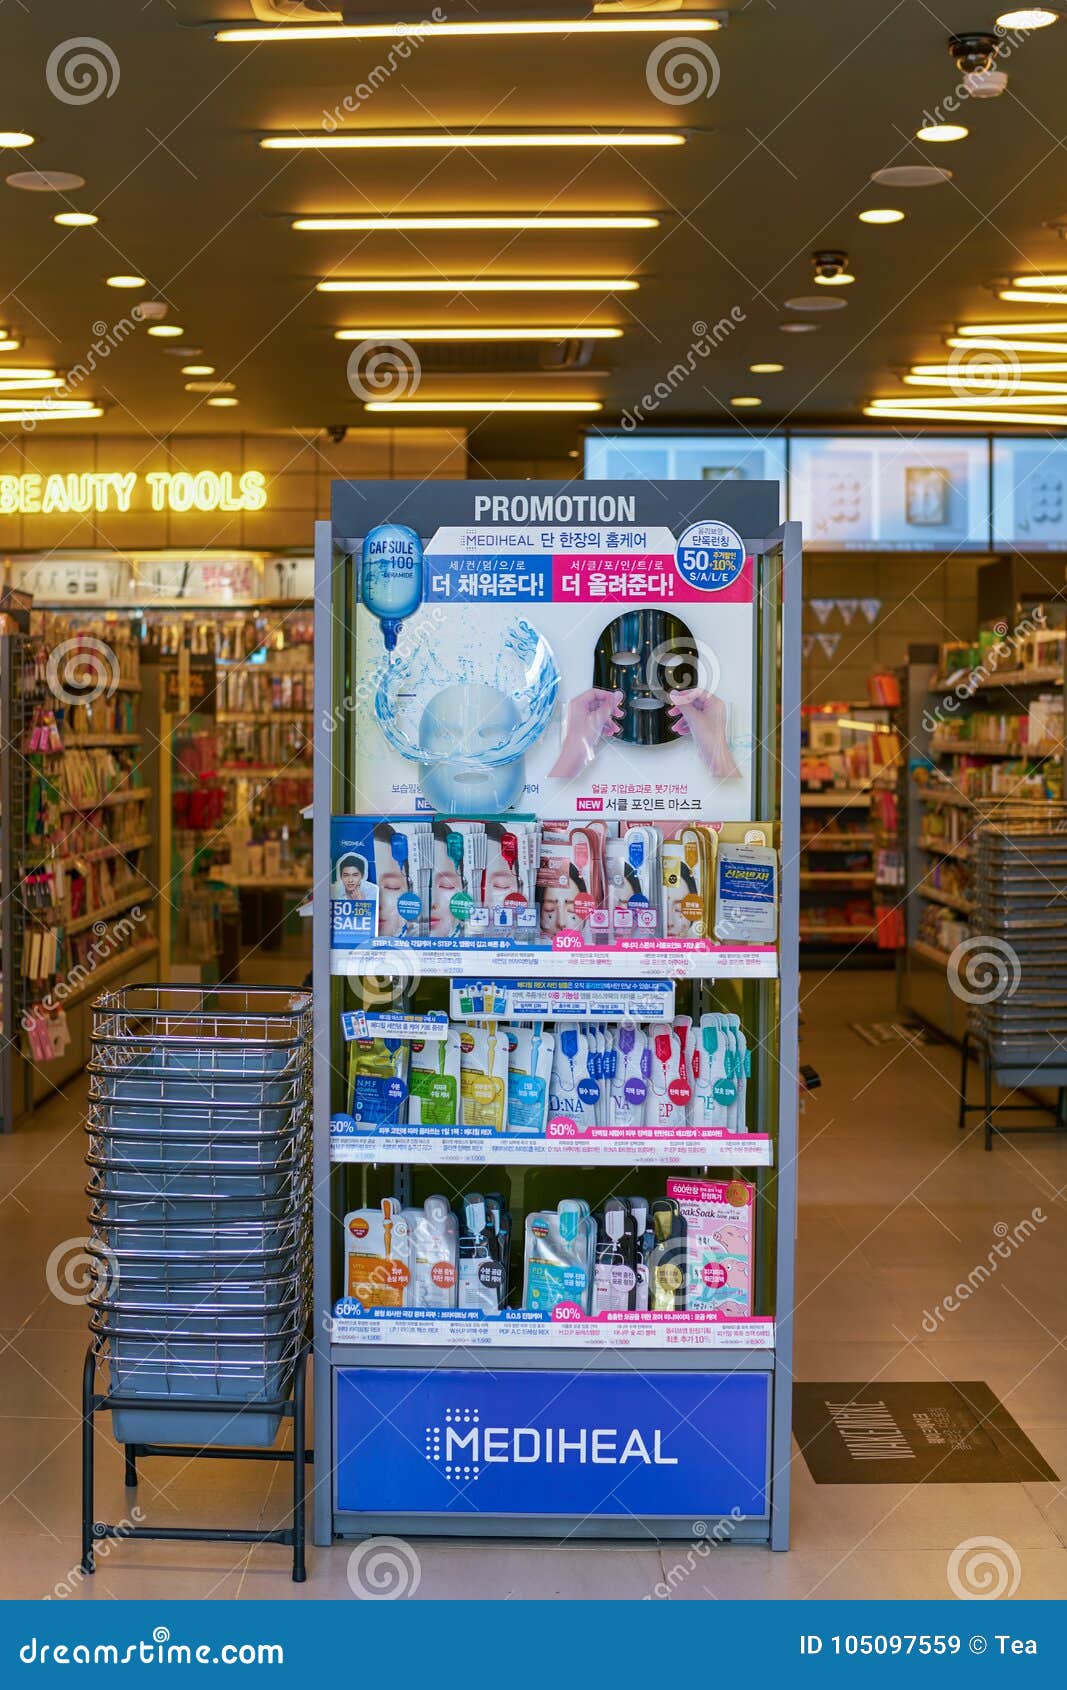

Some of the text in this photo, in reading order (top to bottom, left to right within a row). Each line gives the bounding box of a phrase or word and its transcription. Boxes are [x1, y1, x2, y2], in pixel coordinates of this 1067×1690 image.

[0, 470, 267, 514] BEAUTY TOOLS
[474, 495, 636, 522] PROMOTION
[464, 532, 647, 548] MEDIHEAL 단 한장의 홈케어
[692, 535, 730, 548] 단독런칭
[390, 556, 414, 570] 100
[683, 550, 709, 571] 50
[432, 573, 545, 597] 더 채워준다!
[561, 573, 674, 597] 더 올려준다!
[591, 783, 609, 794] 얼굴
[611, 783, 653, 794] 지압효과로
[578, 799, 602, 809] NEW
[606, 798, 702, 811] 서클 포인트 마스크
[333, 901, 353, 916] 50
[333, 916, 371, 931] SALE
[555, 936, 582, 949] 50%
[549, 1095, 584, 1113] D:NA
[549, 1123, 576, 1136] 50%
[680, 1207, 715, 1219] oakSoak
[555, 1307, 581, 1319] 50%
[445, 1426, 679, 1465] MEDIHEAL
